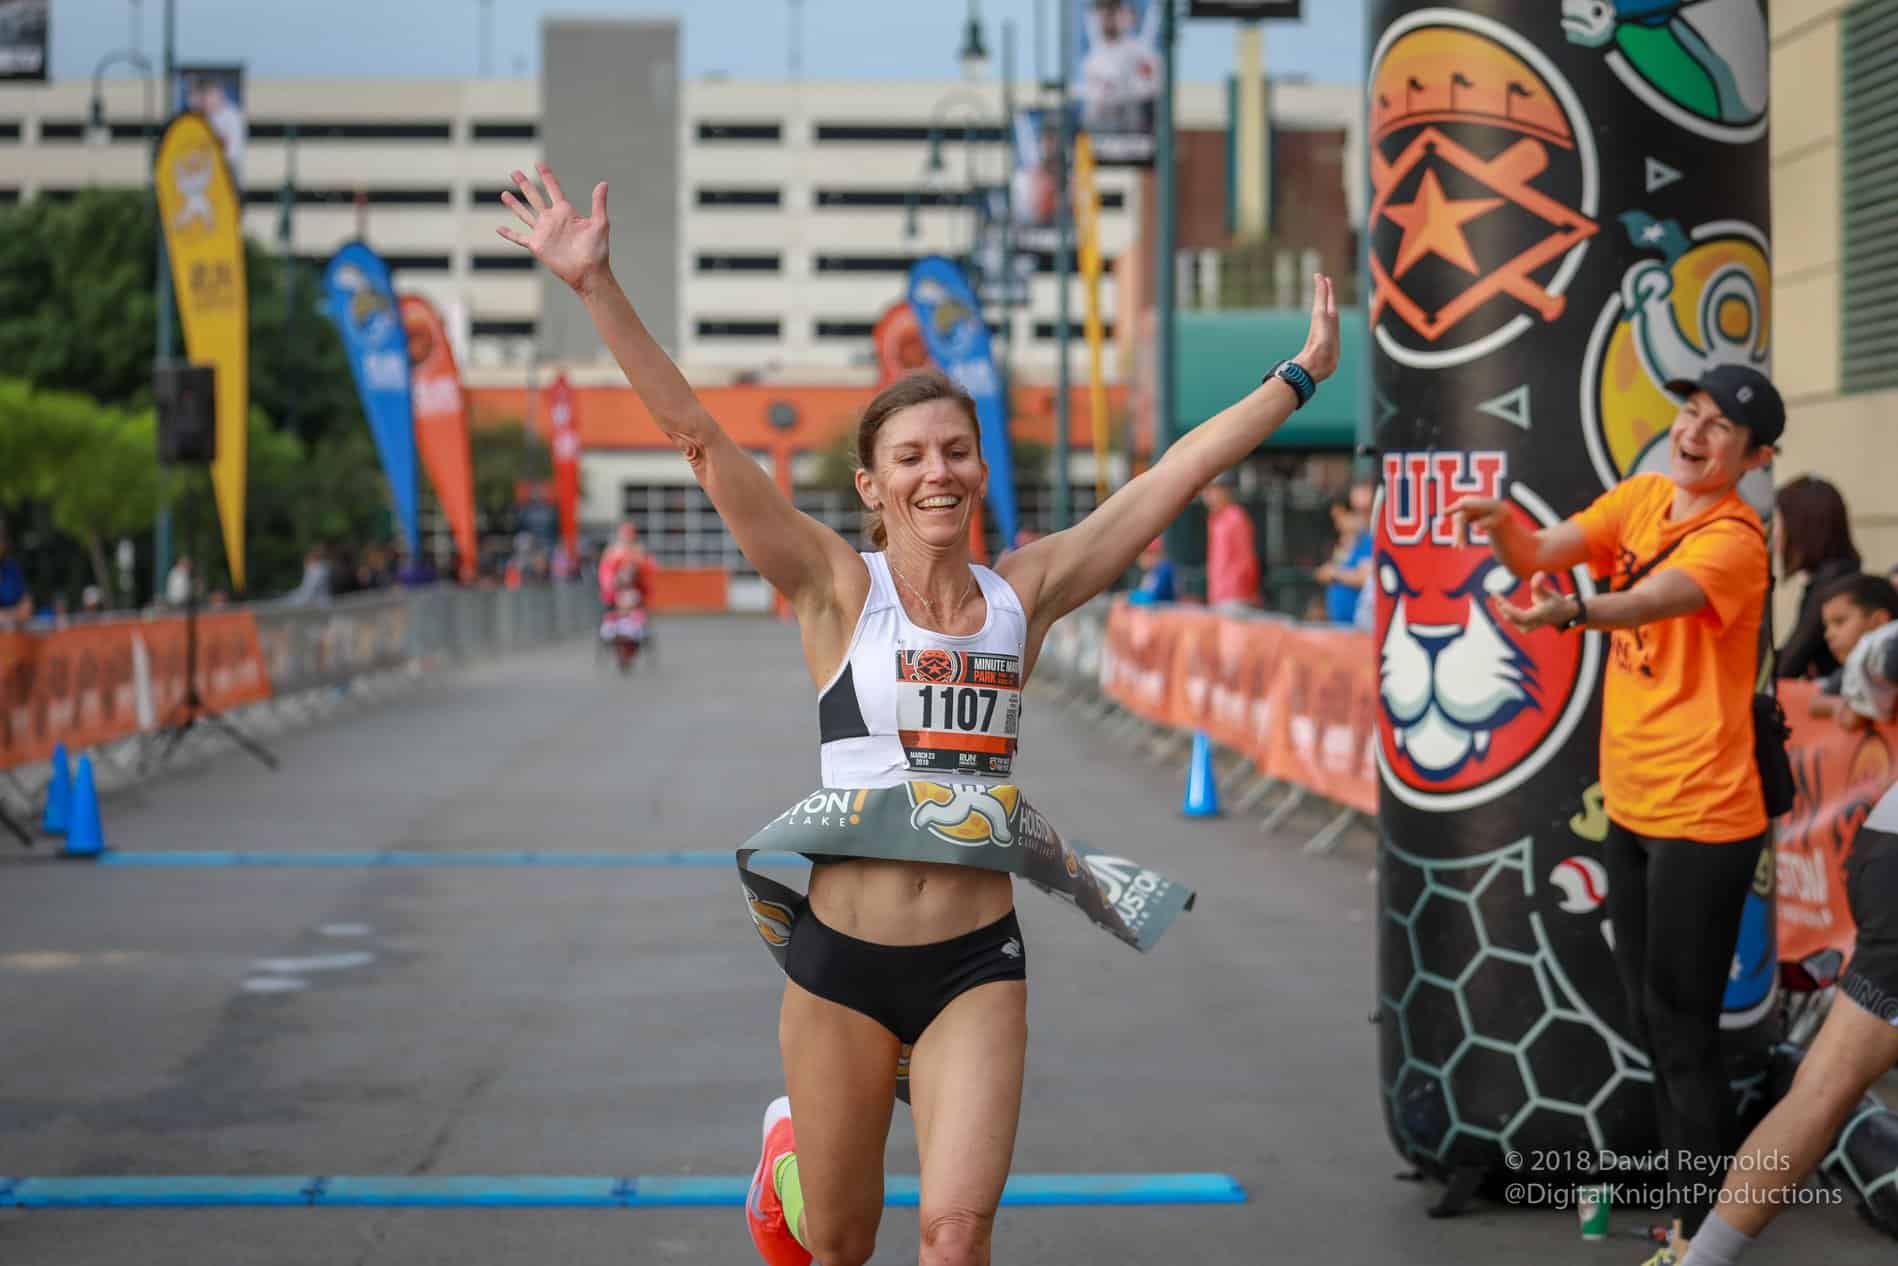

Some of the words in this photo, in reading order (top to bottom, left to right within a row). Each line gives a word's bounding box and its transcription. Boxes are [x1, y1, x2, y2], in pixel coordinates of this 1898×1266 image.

[1383, 451, 1507, 545] UH
[974, 658, 1006, 672] MINUTE
[919, 685, 998, 733] 1107
